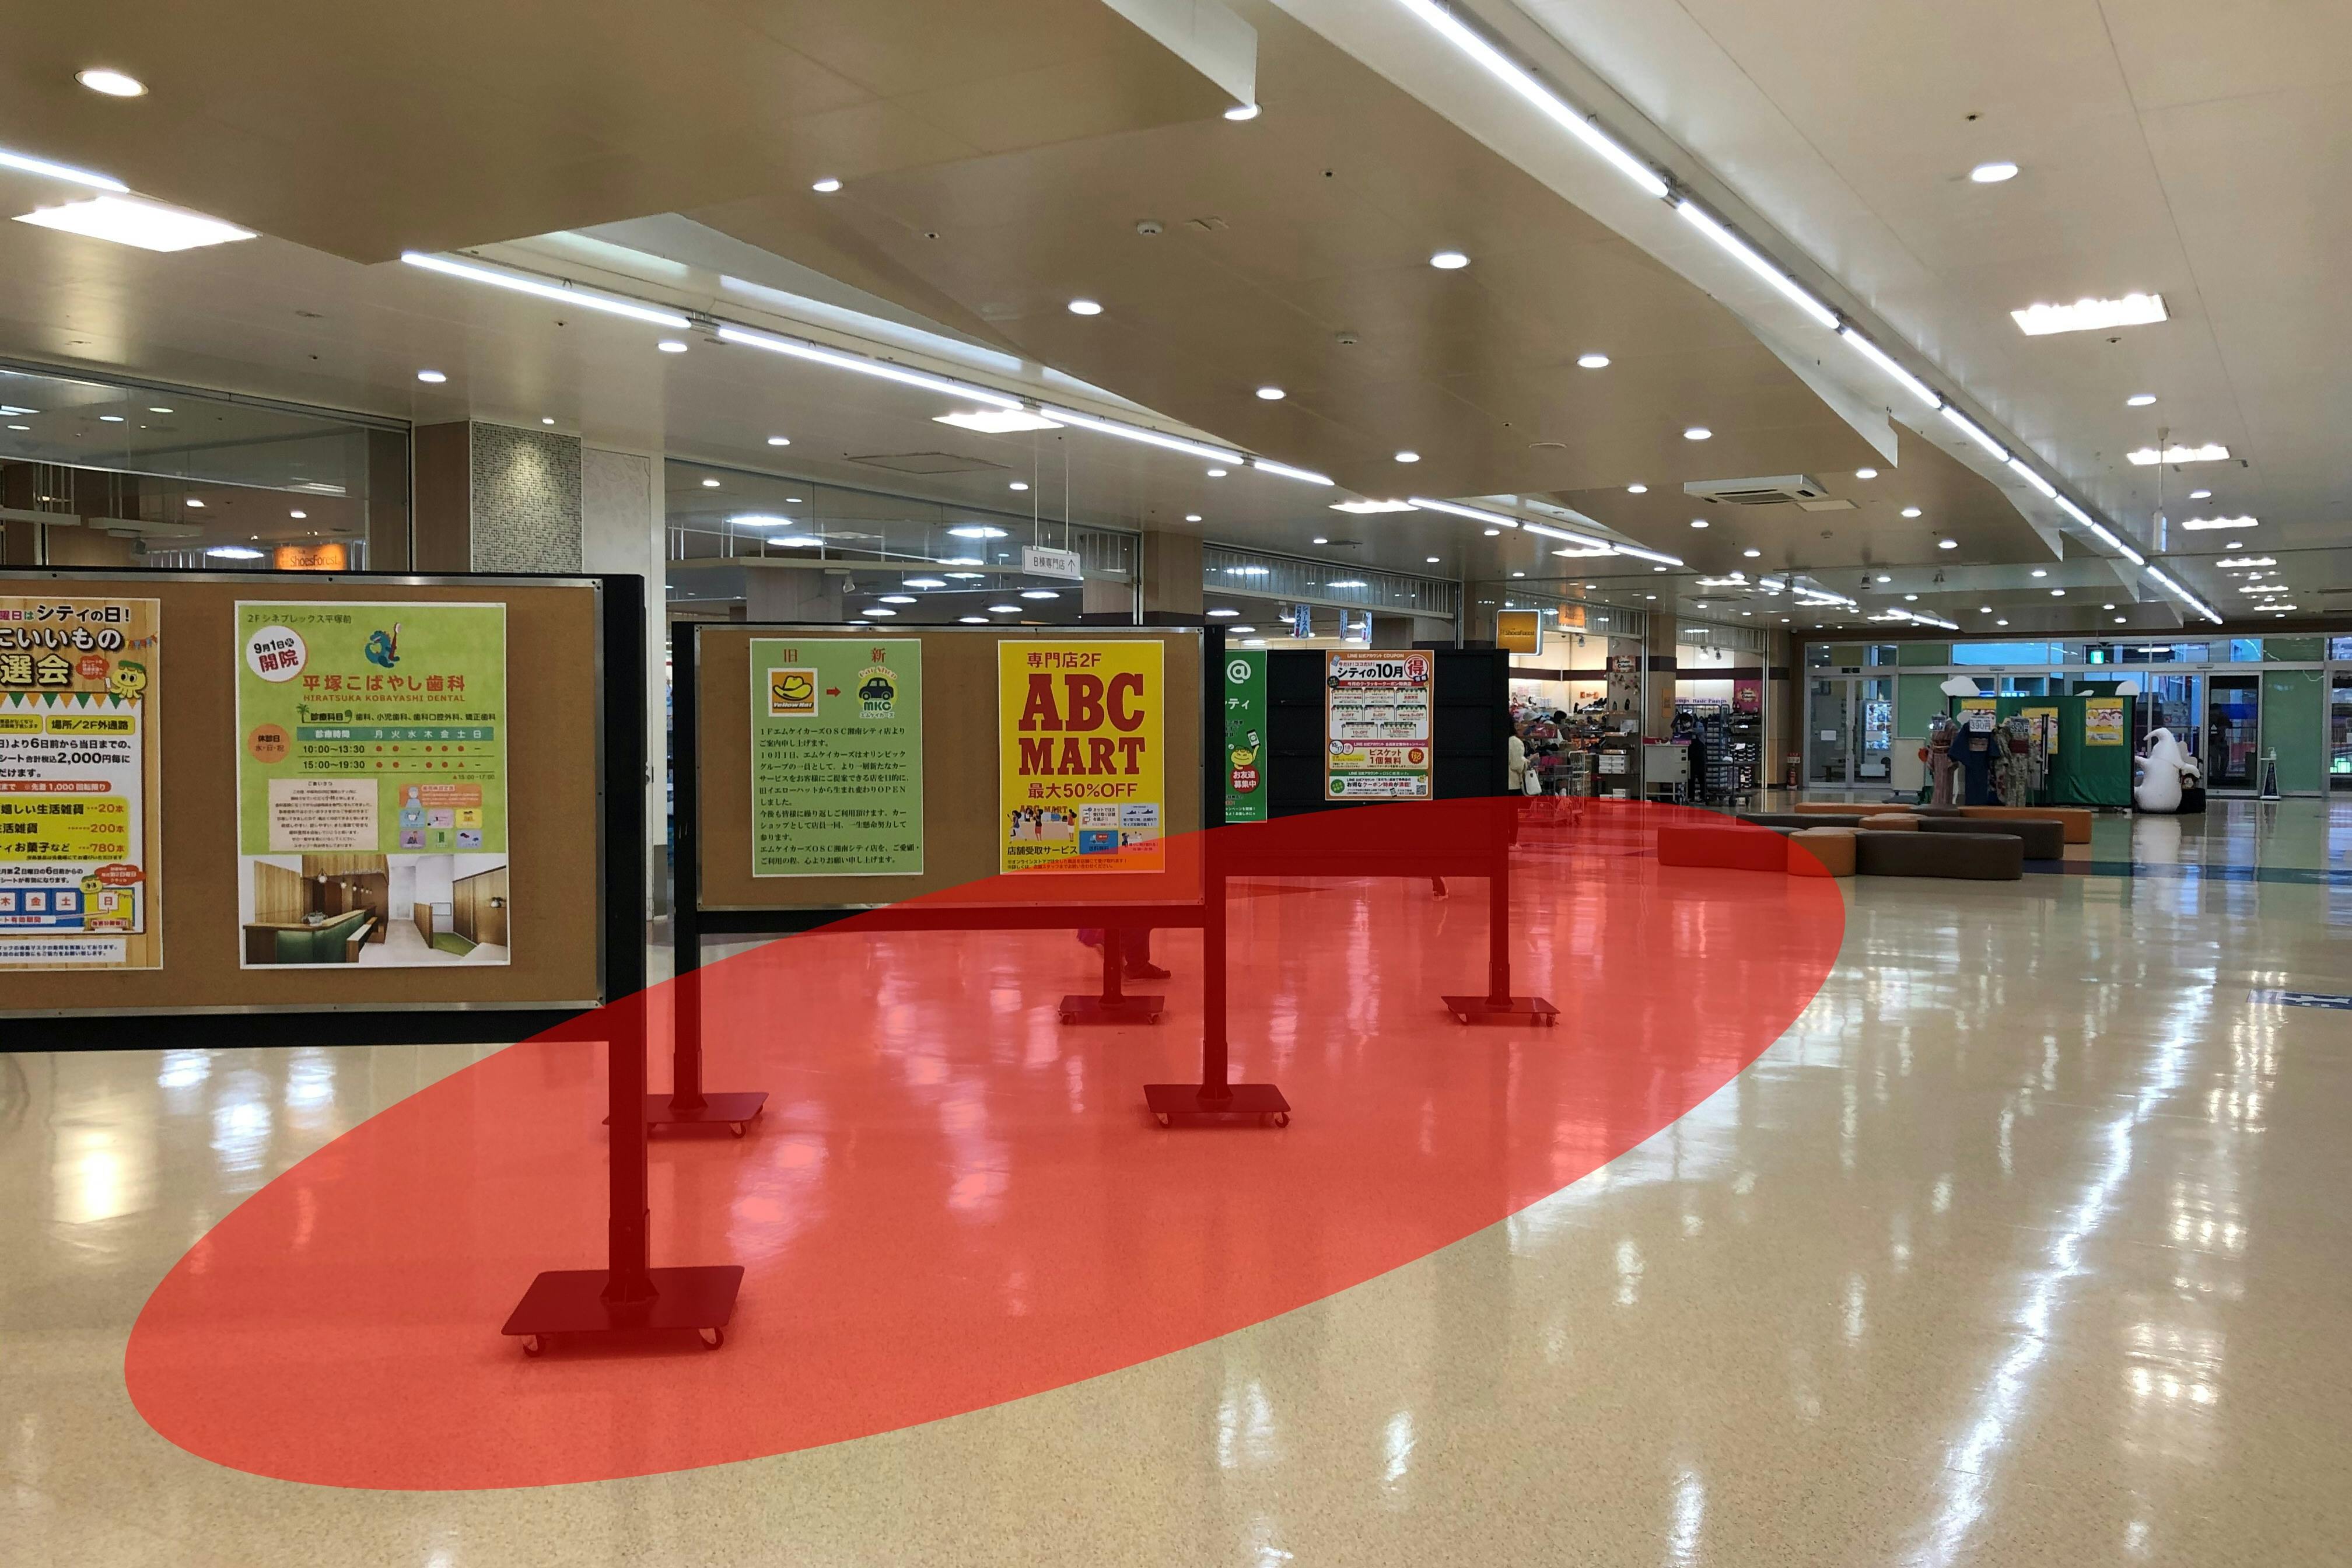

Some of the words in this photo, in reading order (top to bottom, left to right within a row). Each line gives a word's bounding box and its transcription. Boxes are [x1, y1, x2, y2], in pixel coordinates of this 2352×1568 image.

[1034, 556, 1065, 570] B棟専門店
[258, 649, 299, 673] 開院
[784, 649, 797, 663] 旧
[872, 648, 886, 663] 新
[1027, 652, 1102, 668] 専門店2F
[1338, 664, 1403, 678] シティの10月
[1408, 660, 1424, 676] 得
[303, 675, 465, 691] 平塚こばやし歯科
[1019, 673, 1145, 732] ABC
[1225, 698, 1250, 710] ティ
[374, 730, 383, 738] 月
[391, 730, 400, 738] 火
[408, 730, 417, 738] 水
[424, 730, 433, 738] 木
[440, 730, 449, 738] 金
[457, 730, 466, 738] 土
[473, 730, 481, 738] 日
[760, 739, 828, 747] ご案内申し上げます。
[1019, 737, 1146, 775] MART
[1233, 771, 1255, 779] お友達
[1028, 783, 1138, 799] 最大50%OFF
[0, 823, 38, 834] 活雑貨
[0, 842, 70, 852] ィお菓子など
[1007, 846, 1078, 855] 店舗受取サービス
[32, 897, 41, 906] 金
[61, 897, 71, 906] 土
[104, 896, 113, 906] 日
